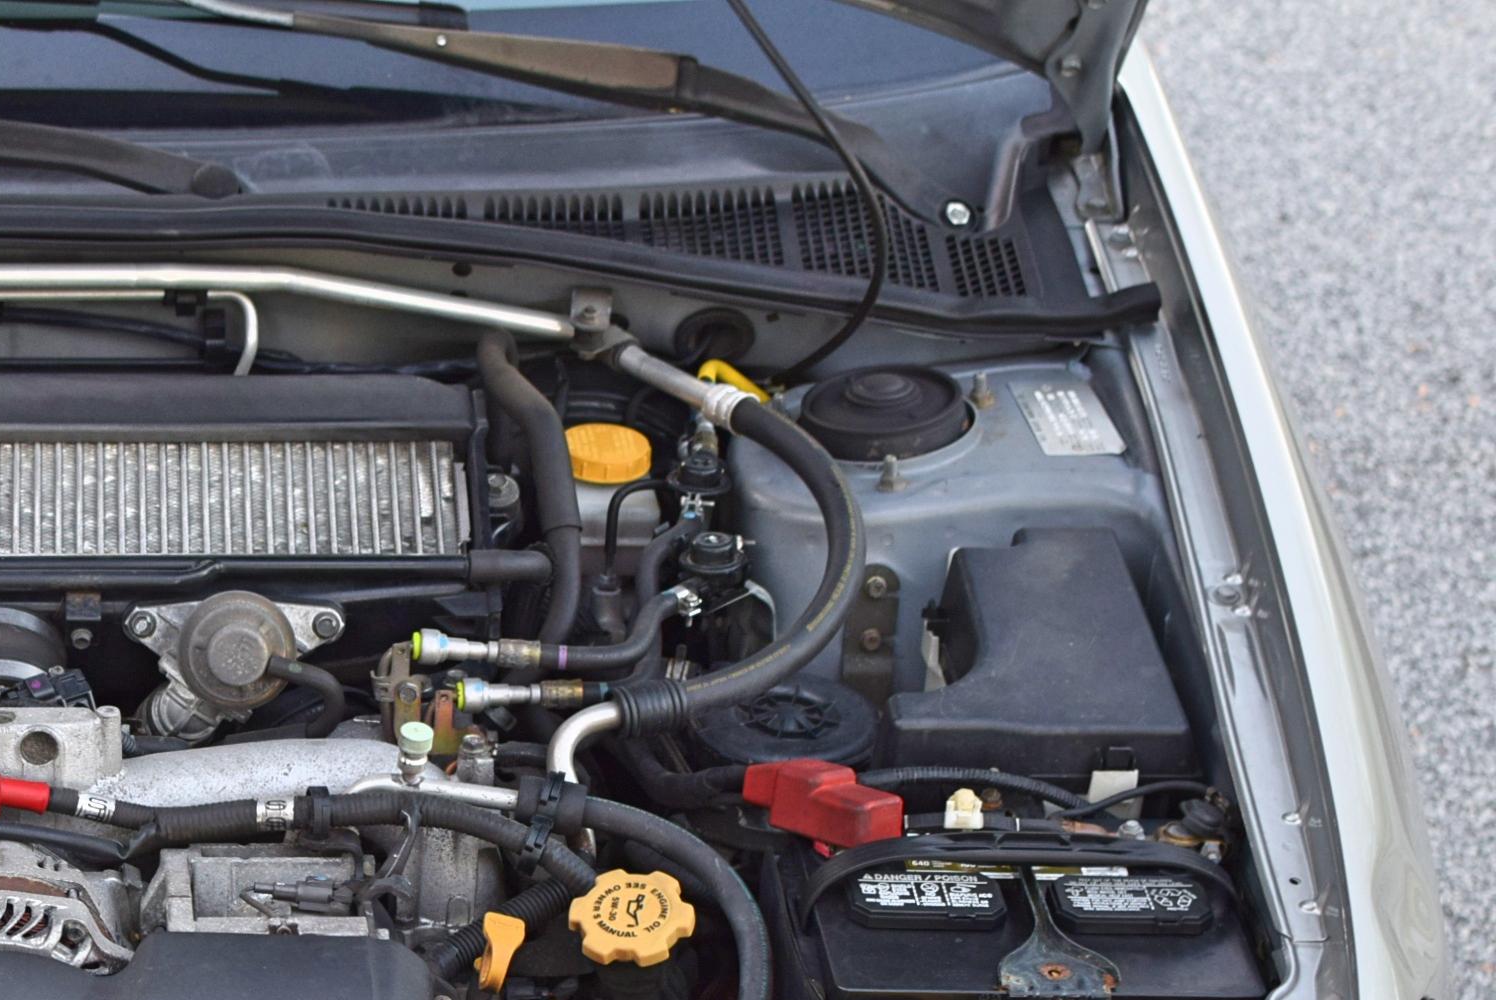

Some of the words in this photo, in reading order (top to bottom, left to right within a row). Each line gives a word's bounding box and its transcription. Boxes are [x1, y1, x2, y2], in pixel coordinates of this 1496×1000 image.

[873, 873, 923, 882] DANGER
[934, 874, 978, 883] POISON
[625, 882, 647, 890] SEE
[608, 896, 620, 921] 5W-30
[650, 888, 669, 920] ENGINE
[596, 920, 638, 938] MANUAL
[642, 920, 661, 933] OIL
